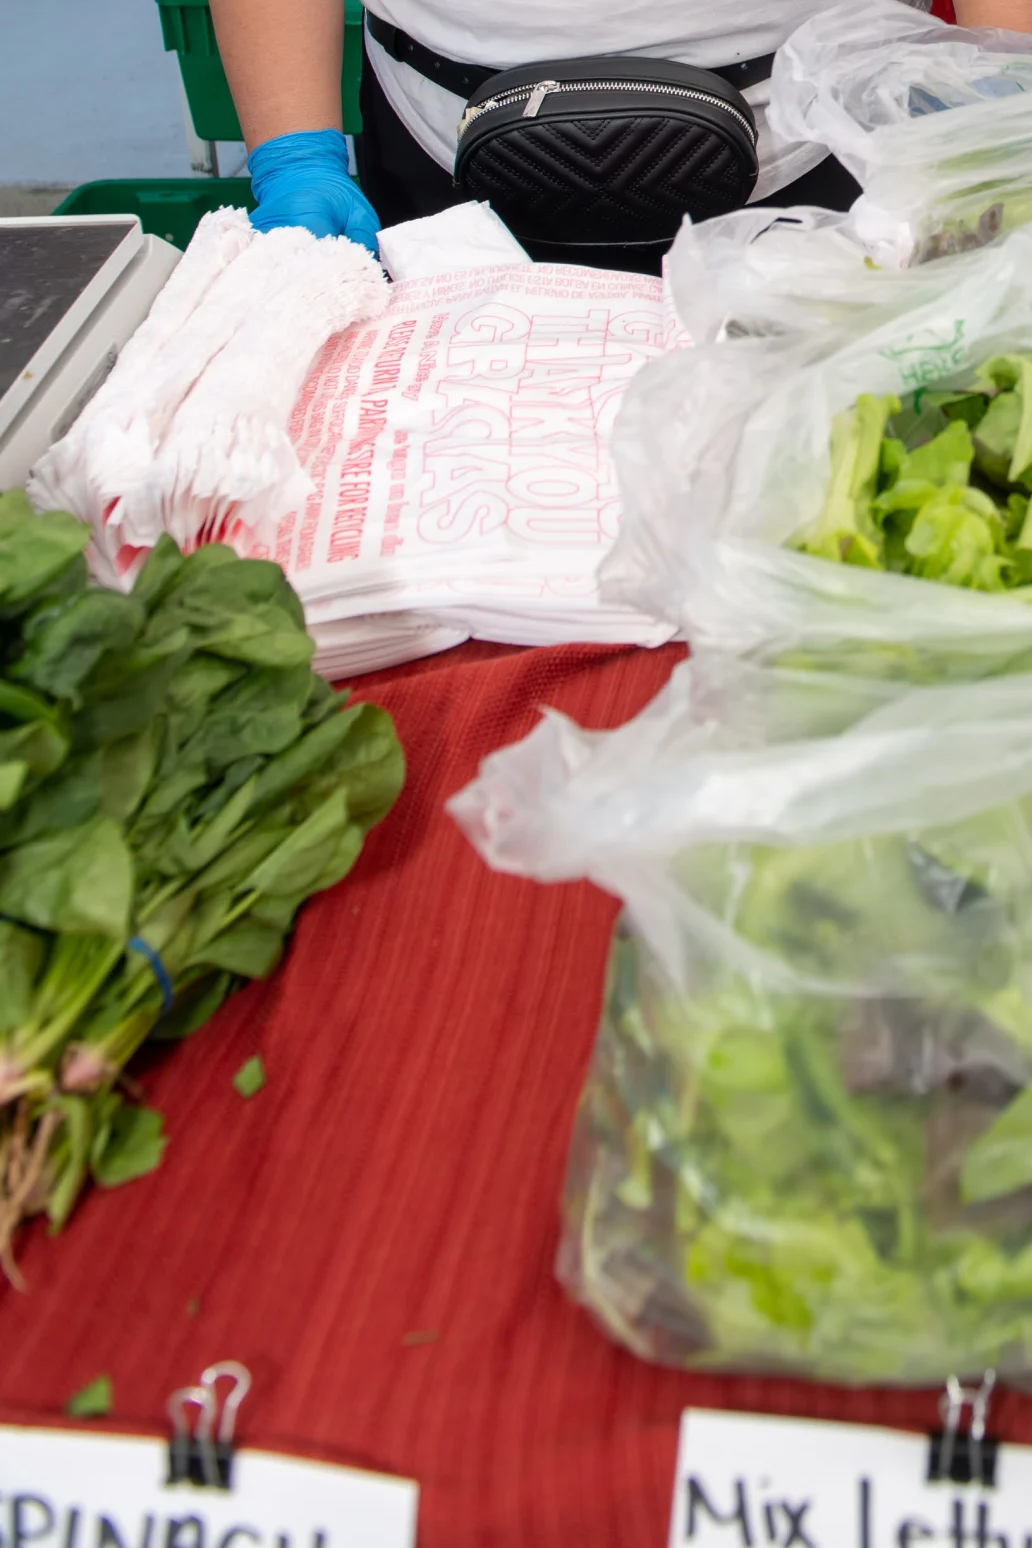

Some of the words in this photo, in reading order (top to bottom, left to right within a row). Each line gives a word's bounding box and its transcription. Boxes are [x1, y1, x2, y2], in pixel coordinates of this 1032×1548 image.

[382, 319, 417, 349] PLEASE
[370, 347, 407, 386] RETURN
[416, 301, 532, 546] GRACIAS
[338, 481, 371, 507] FOR
[326, 507, 368, 564] RECYCLING
[0, 1491, 329, 1548] PINA
[684, 1472, 813, 1548] Mix
